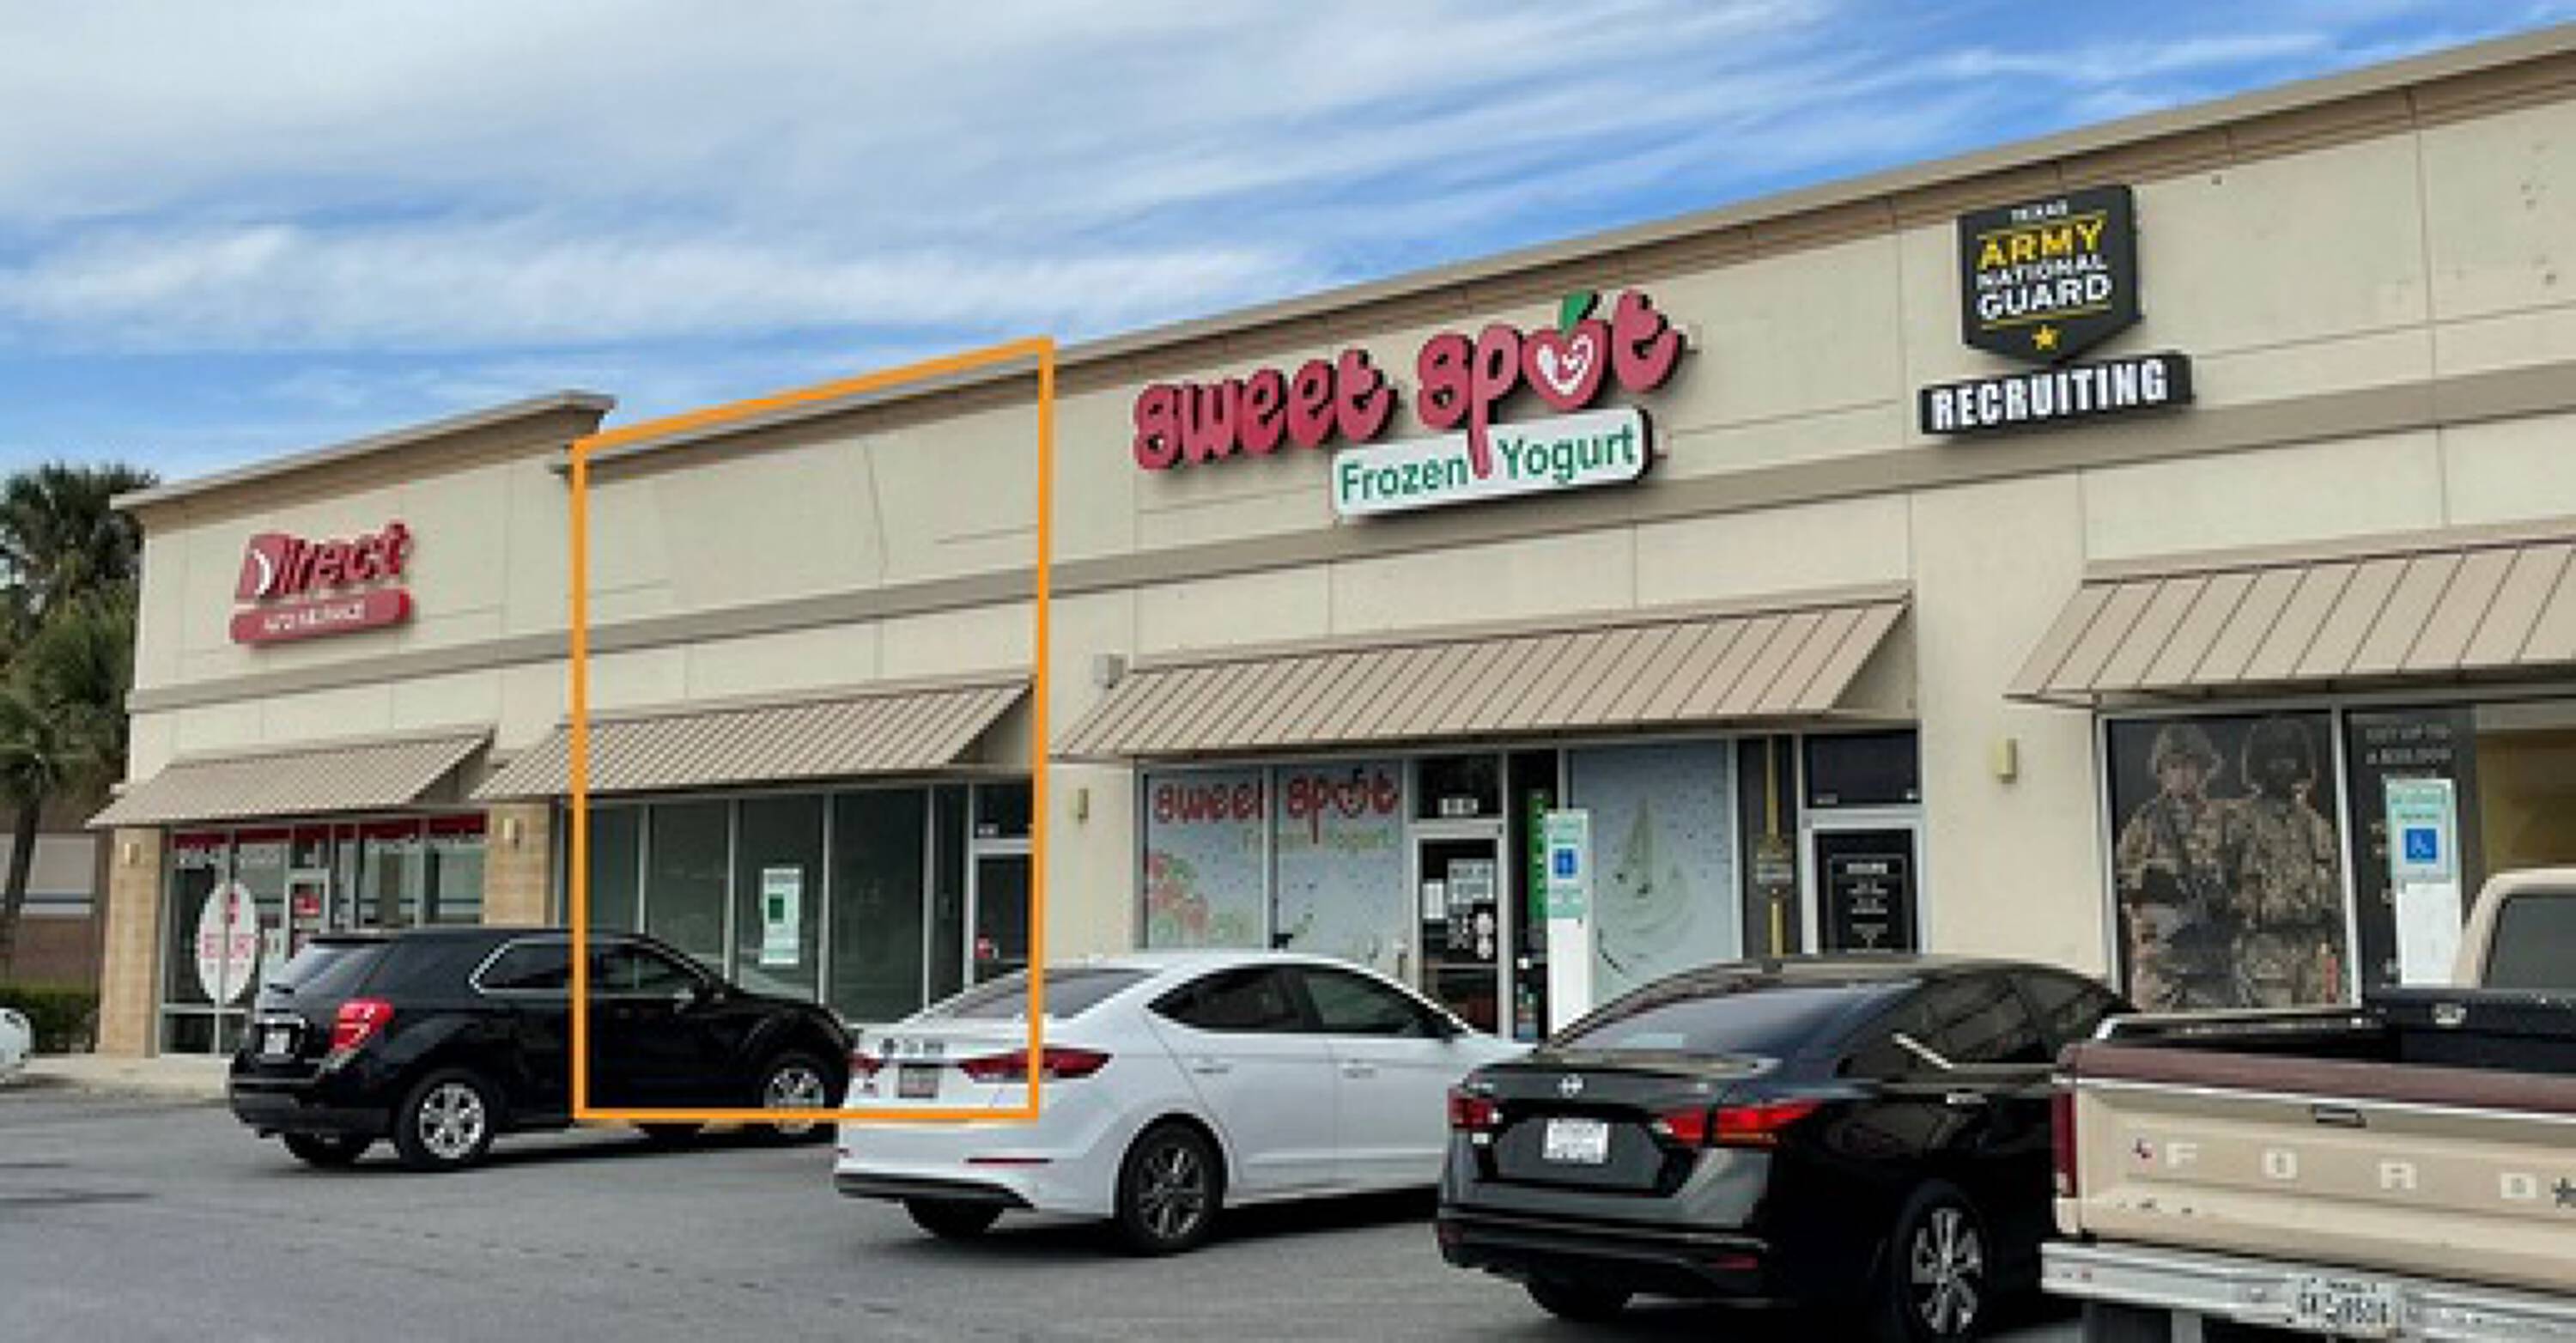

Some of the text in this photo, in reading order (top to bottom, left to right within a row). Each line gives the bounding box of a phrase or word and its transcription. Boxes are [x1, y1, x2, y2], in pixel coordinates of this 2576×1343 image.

[1978, 219, 2105, 270] ARMY
[1977, 252, 2108, 291] NATIONAL
[1978, 273, 2112, 321] GUARD
[1931, 359, 2168, 432] RECRUITING
[1341, 424, 1636, 501] Frozen Yogurt
